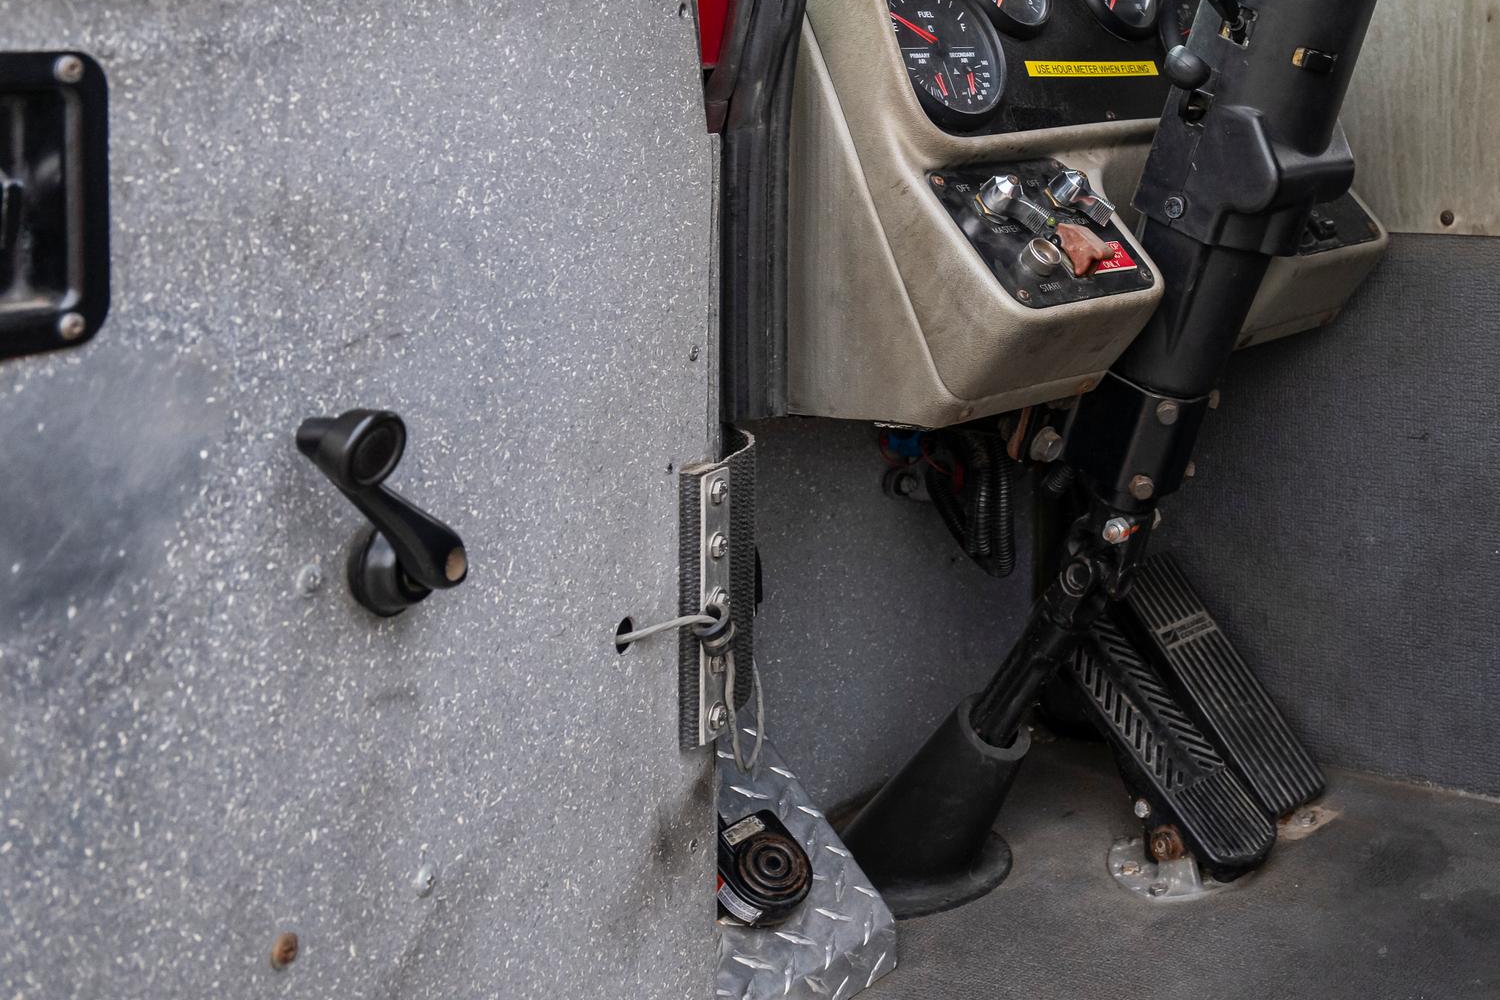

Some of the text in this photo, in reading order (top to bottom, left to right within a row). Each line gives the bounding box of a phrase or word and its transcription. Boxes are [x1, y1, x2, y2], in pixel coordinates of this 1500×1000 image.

[917, 10, 935, 18] FUEL
[960, 23, 966, 32] F
[1034, 64, 1151, 74] USE HOUR METER WHEN FUELING
[1027, 179, 1040, 187] OFF
[956, 184, 970, 192] OFF
[992, 224, 1020, 235] MASTER
[1102, 260, 1122, 268] ONLY
[1039, 282, 1062, 292] START
